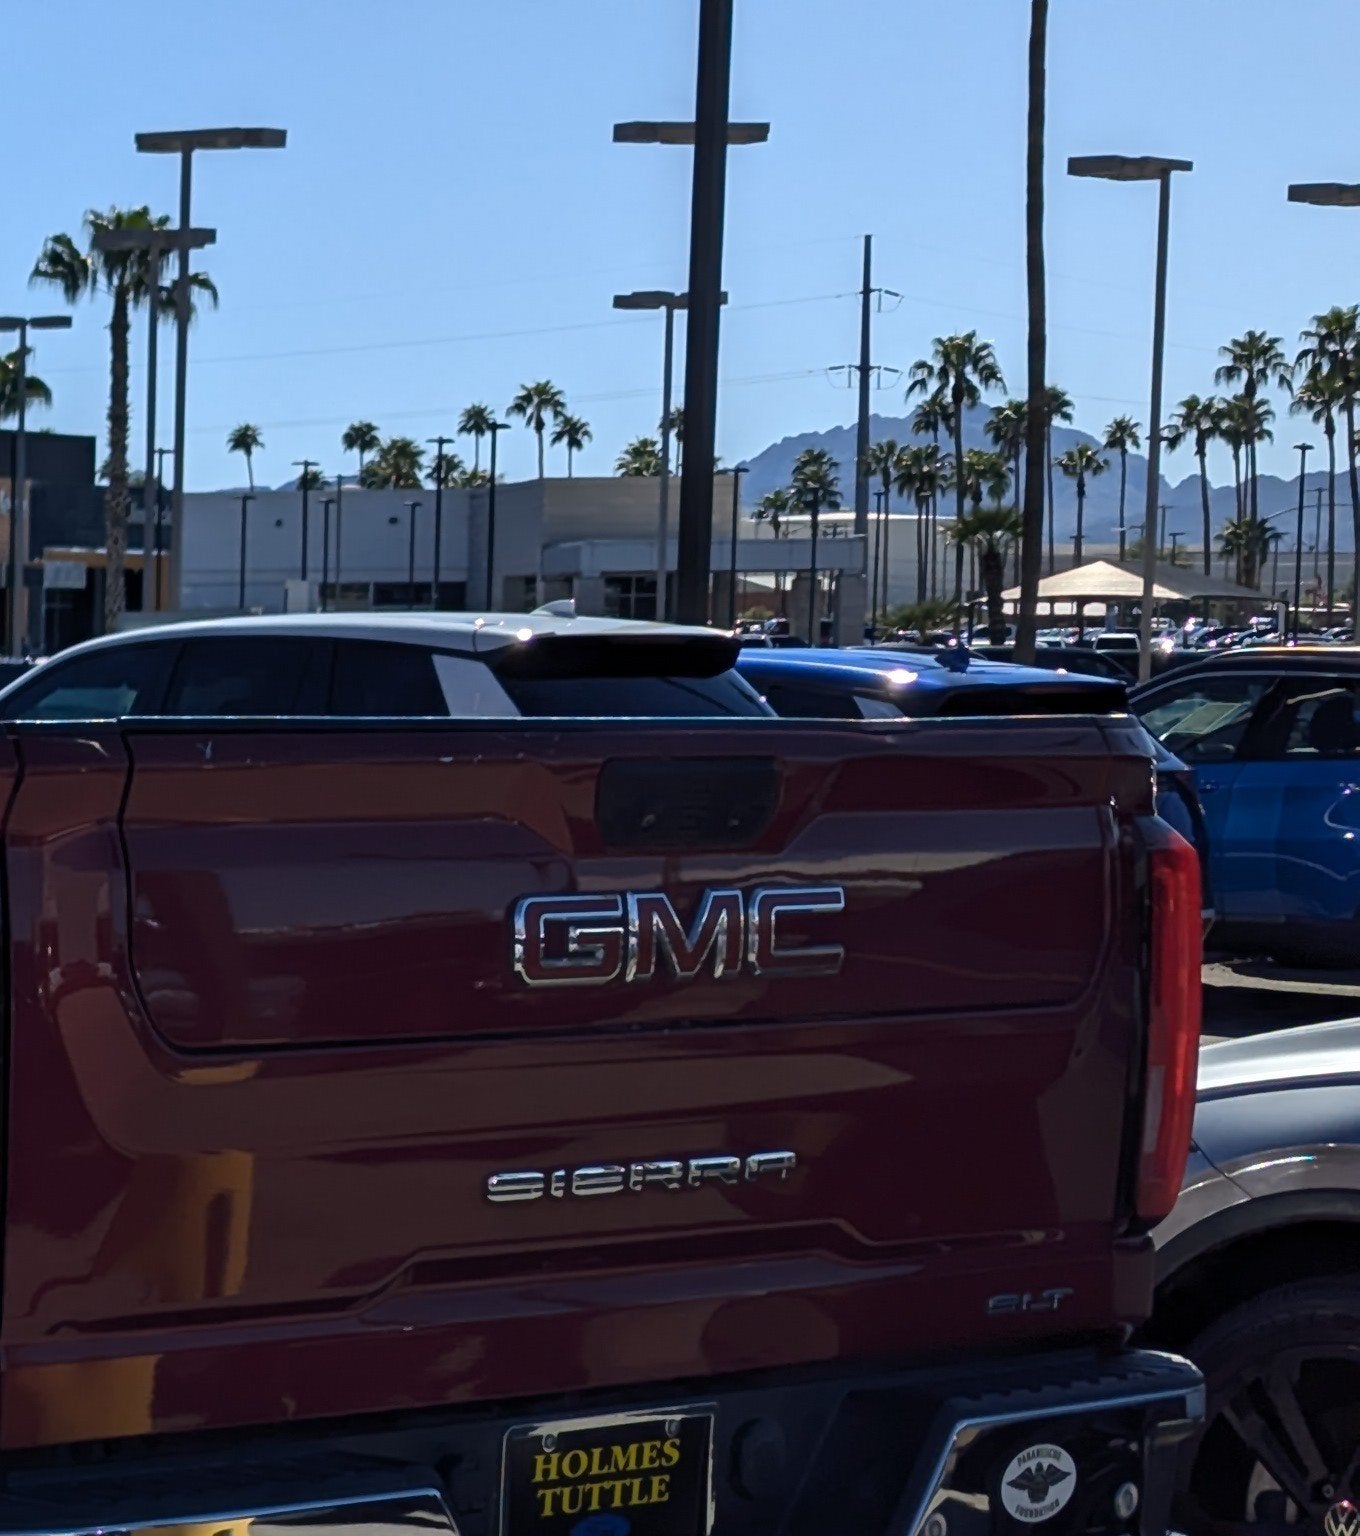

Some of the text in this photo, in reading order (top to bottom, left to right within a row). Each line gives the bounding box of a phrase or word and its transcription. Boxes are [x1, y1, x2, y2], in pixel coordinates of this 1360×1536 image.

[514, 885, 846, 988] GMC
[486, 1149, 797, 1203] SIERRA
[987, 1287, 1075, 1314] SLT
[532, 1437, 682, 1483] HOLMES
[536, 1474, 672, 1518] TUTTLE
